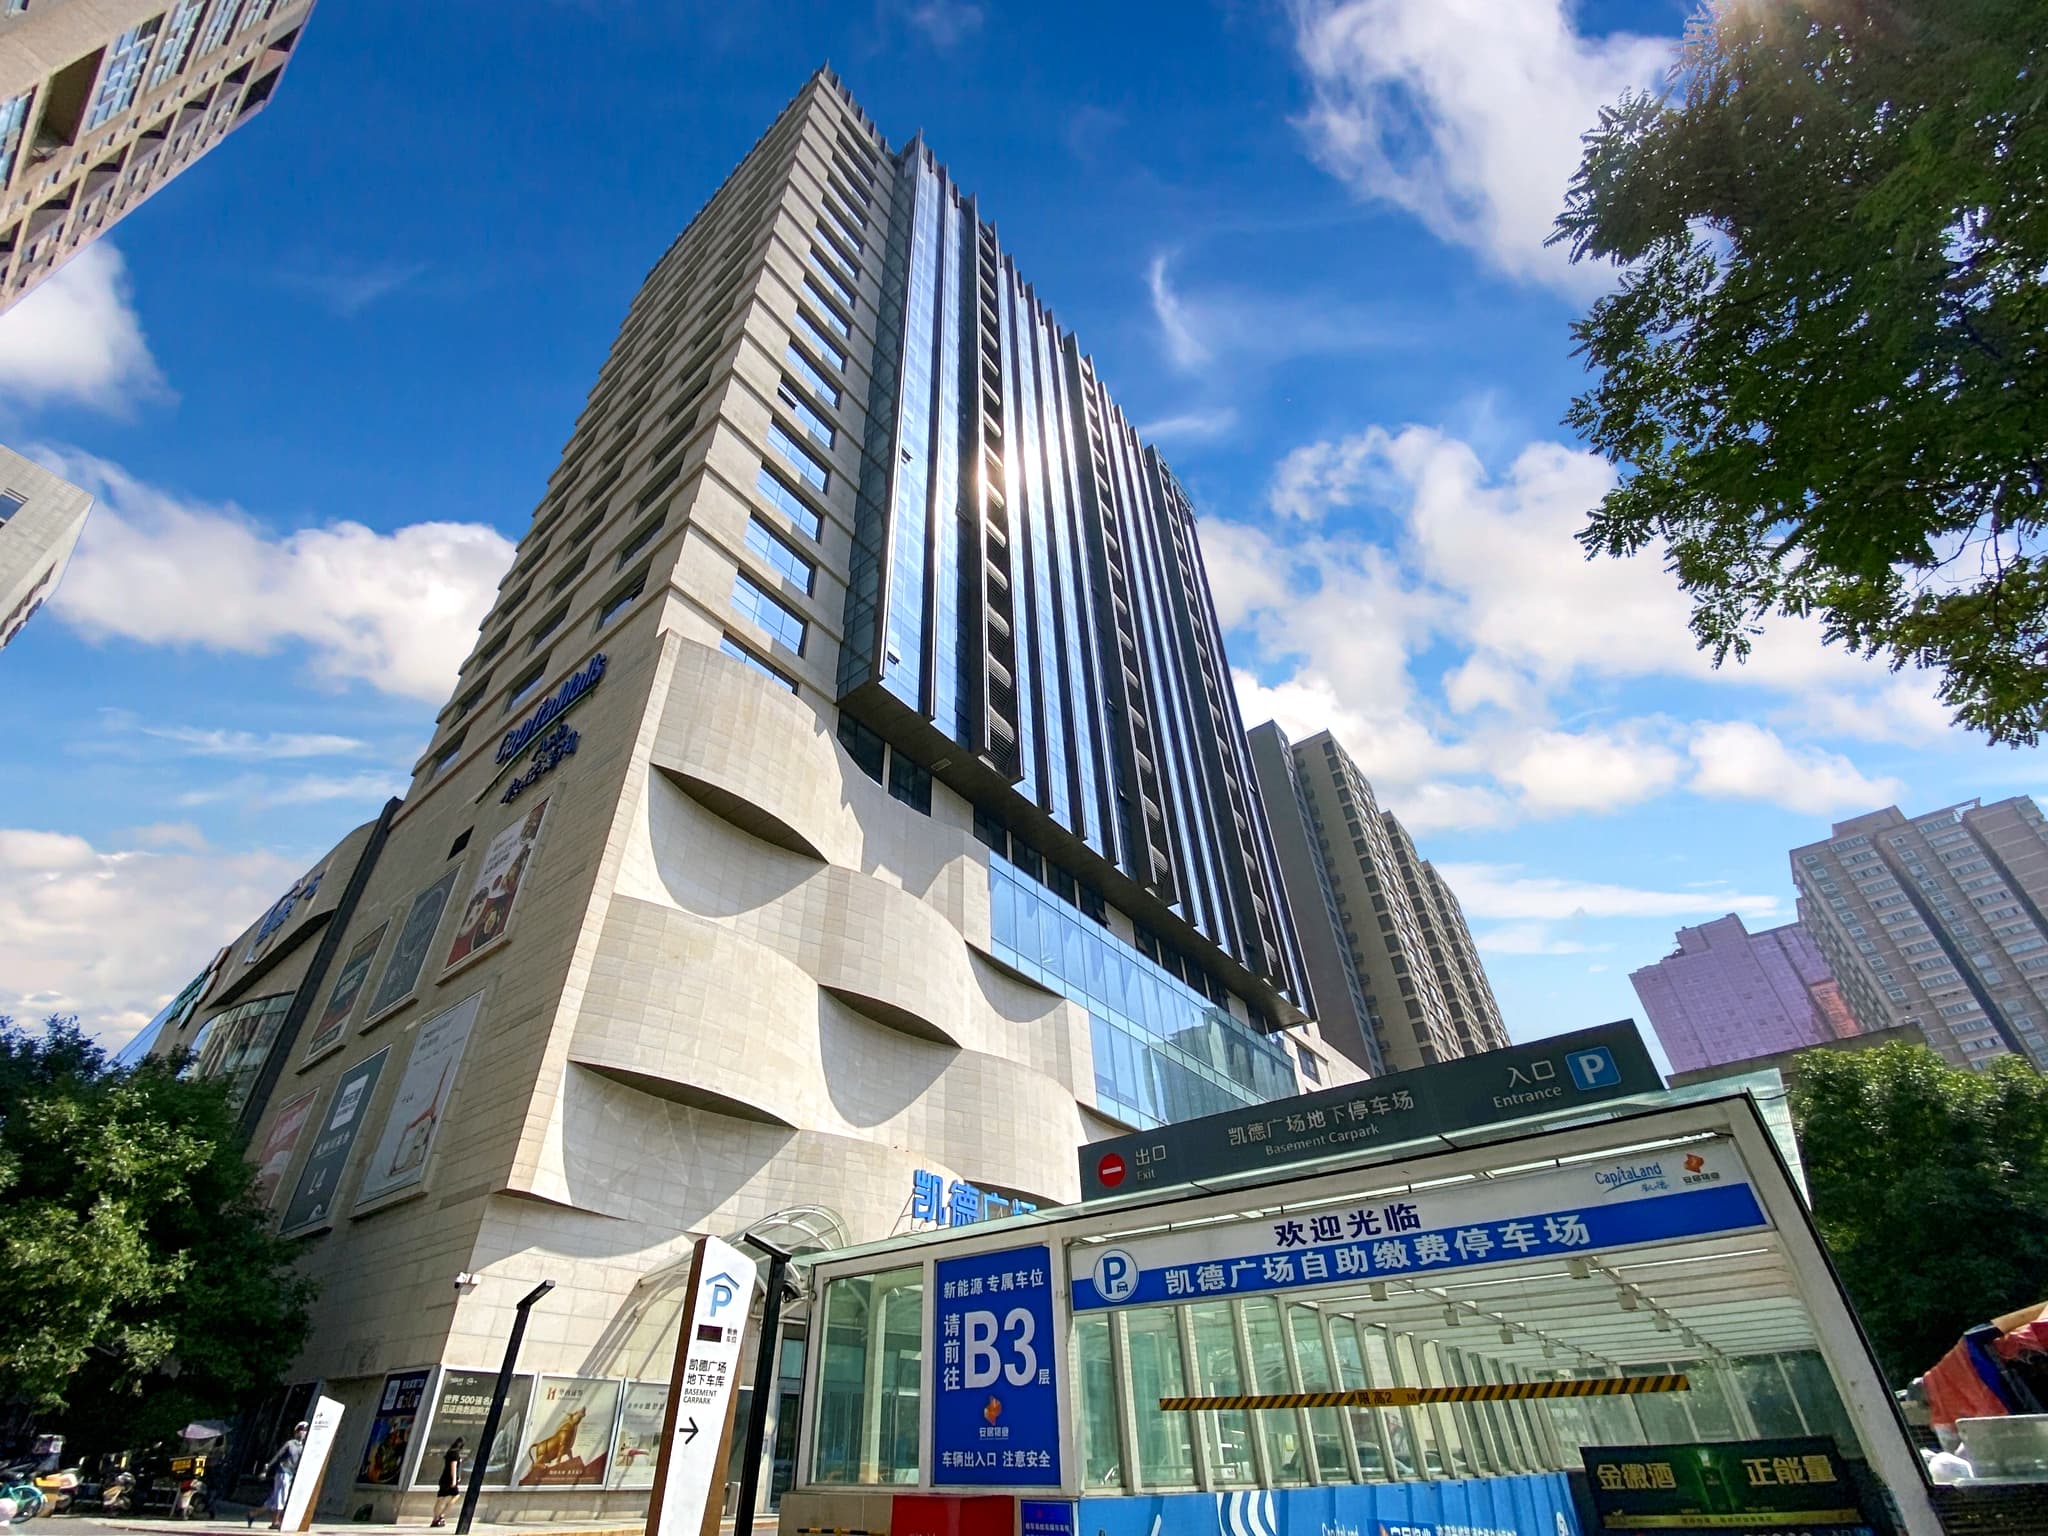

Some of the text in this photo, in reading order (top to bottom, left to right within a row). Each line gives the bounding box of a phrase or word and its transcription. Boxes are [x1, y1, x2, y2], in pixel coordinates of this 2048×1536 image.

[1507, 1060, 1556, 1088] 入口
[1578, 1054, 1604, 1084] P
[1493, 1085, 1563, 1108] Entrance
[1227, 1090, 1415, 1146] 凯德广场地下停车场
[1265, 1124, 1380, 1157] Basement Carpark
[1135, 1145, 1167, 1166] 出口
[1136, 1169, 1156, 1182] Exit
[1594, 1162, 1663, 1187] CapitaLand
[1273, 1203, 1422, 1248] 欢迎光临
[1165, 1214, 1591, 1296] 凯德广场自助缴费停车场
[944, 1267, 1044, 1299] 新能源 专属车位
[943, 1312, 960, 1392] 请前往
[964, 1307, 1037, 1389] B3
[689, 1358, 727, 1374] 凯德广场
[1039, 1368, 1050, 1385] 层
[684, 1387, 717, 1397] BASEMENT
[686, 1372, 725, 1387] 地下车库
[683, 1396, 711, 1404] CARPARK
[942, 1450, 1051, 1468] 车辆出入口 注意安全
[1596, 1454, 1838, 1490] 金徽酒 正能量
